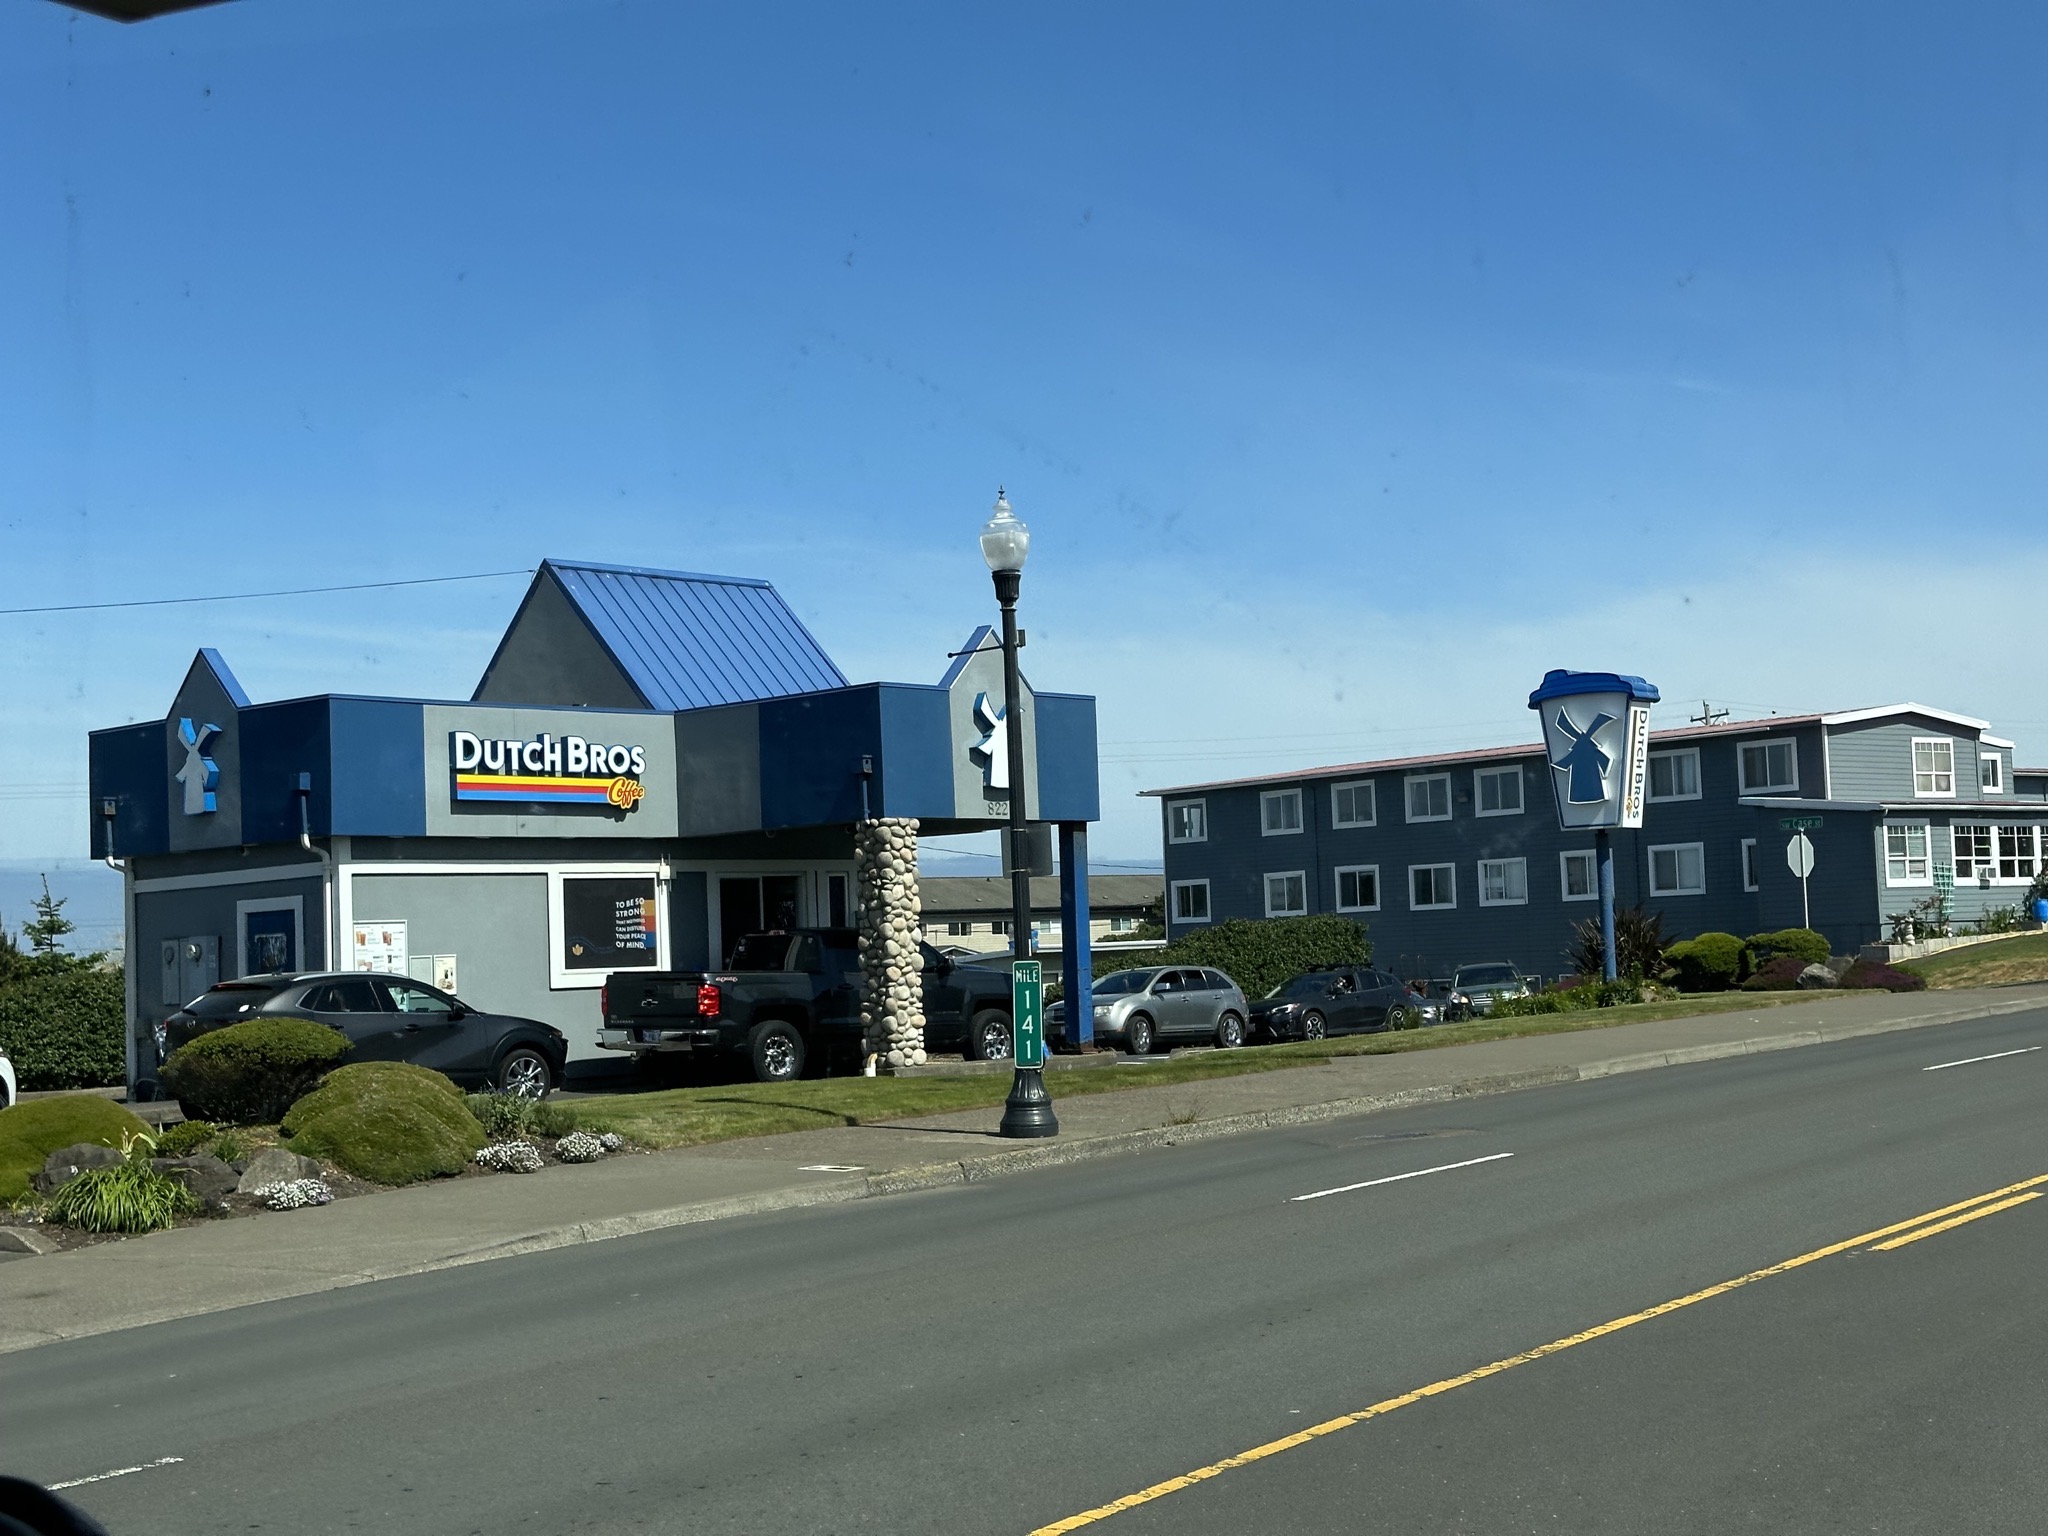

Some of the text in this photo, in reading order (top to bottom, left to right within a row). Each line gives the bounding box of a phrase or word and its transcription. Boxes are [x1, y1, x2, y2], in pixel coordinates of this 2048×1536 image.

[567, 735, 646, 775] BROS
[608, 777, 645, 808] Coffee
[1632, 773, 1643, 819] BROS
[987, 801, 1009, 816] 822
[1792, 819, 1812, 828] Case
[616, 908, 645, 917] STRONG
[1015, 969, 1039, 983] MILE
